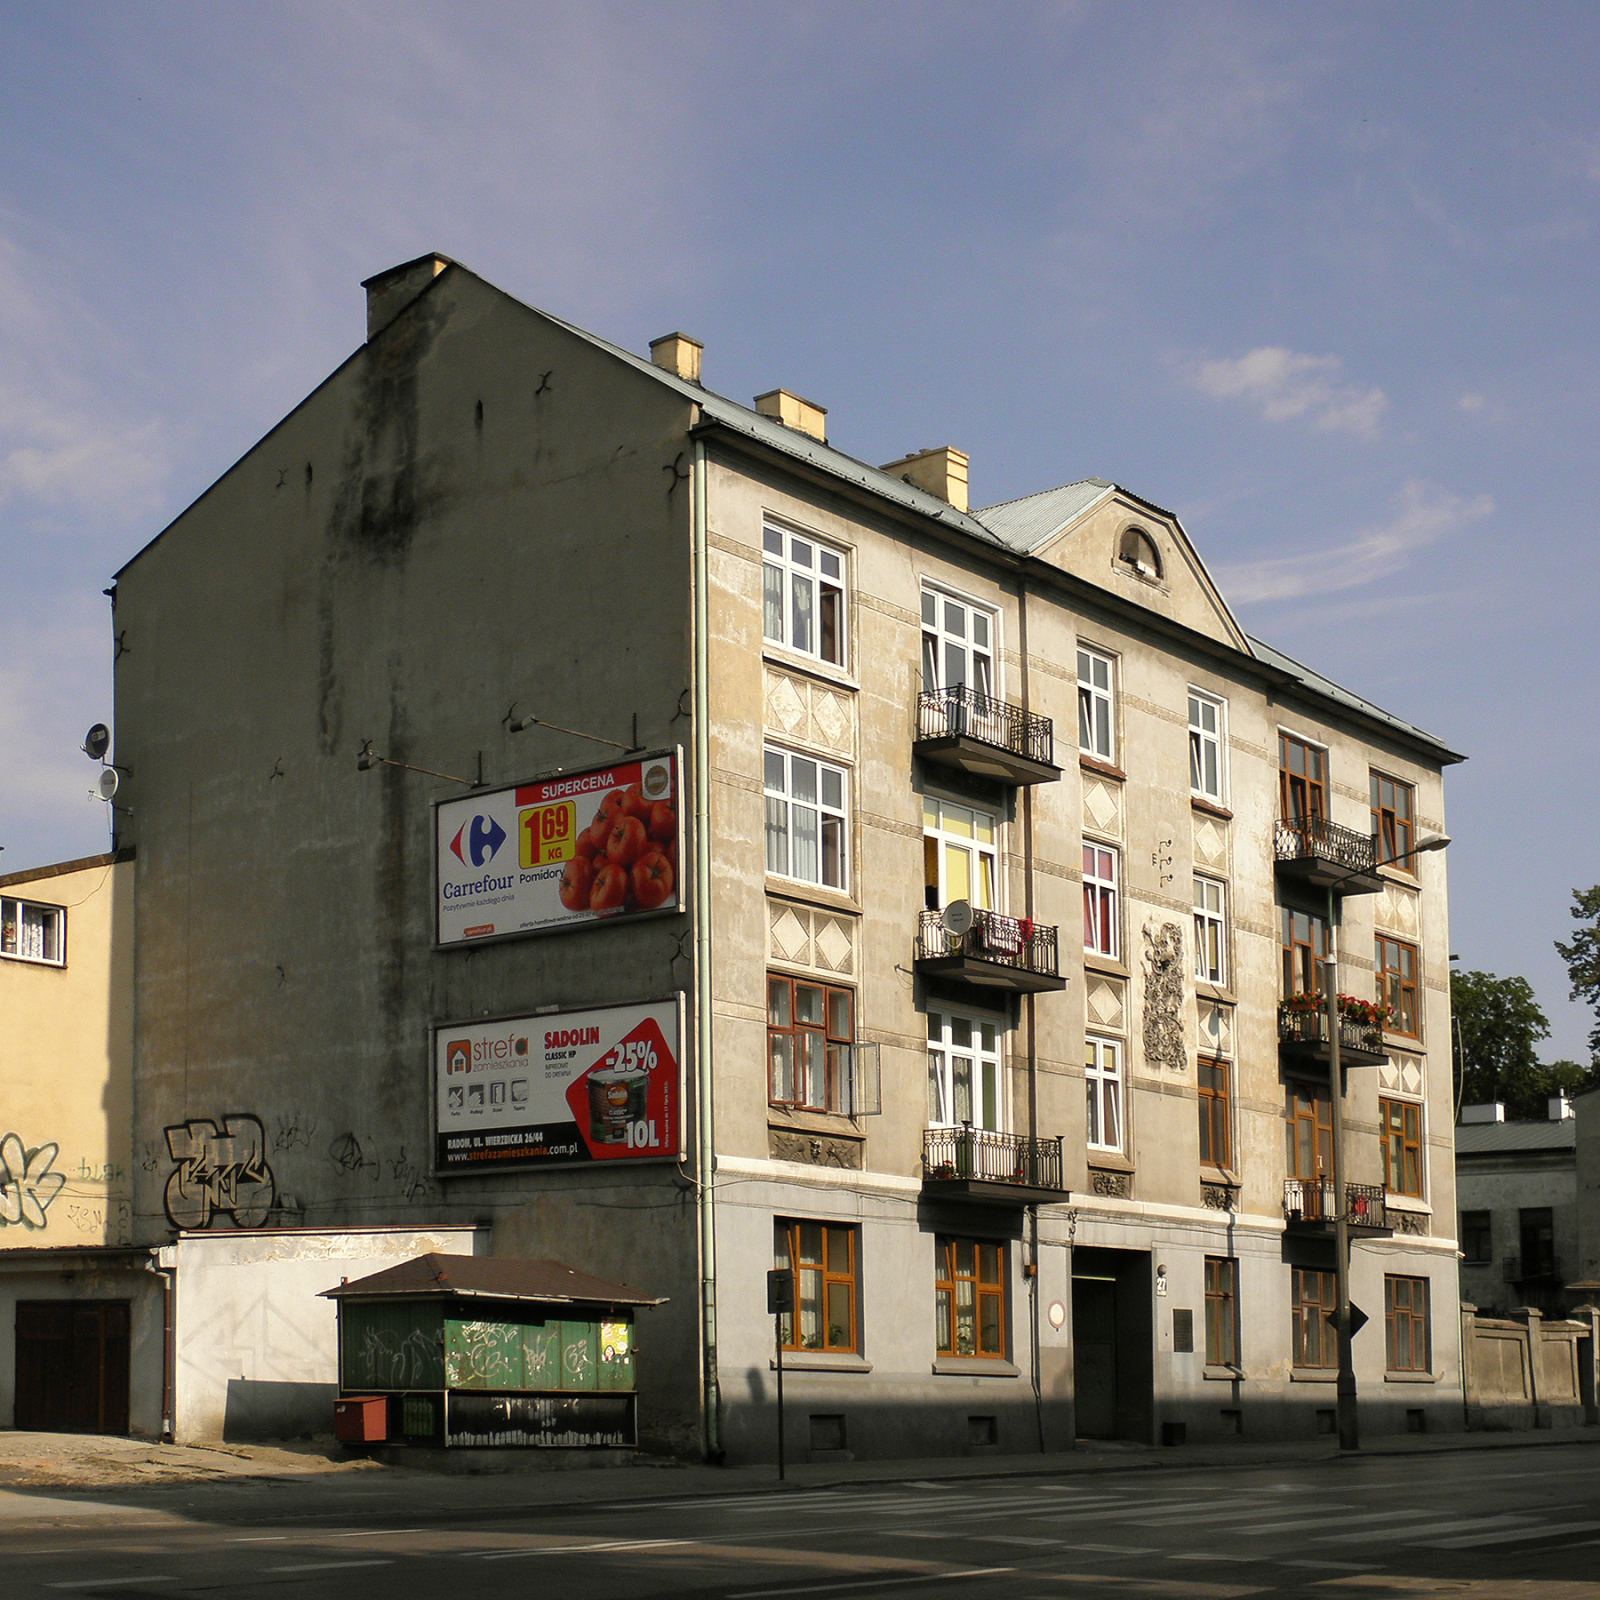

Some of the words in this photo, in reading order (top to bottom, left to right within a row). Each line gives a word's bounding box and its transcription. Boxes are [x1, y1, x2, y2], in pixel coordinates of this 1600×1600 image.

[541, 772, 615, 799] SUPERCENA
[547, 846, 563, 861] KG
[443, 873, 515, 900] Carrefour
[519, 868, 565, 884] Pomidory
[473, 1033, 529, 1061] strefa
[544, 1026, 600, 1050] SADOLIN
[473, 1058, 529, 1073] zamieszkania
[545, 1051, 567, 1061] CLASSIC
[605, 1040, 658, 1073] -25%
[447, 1138, 473, 1150] RADOM,
[485, 1133, 524, 1147] WIERZBICKA
[627, 1119, 660, 1149] 10L
[447, 1142, 578, 1163] www.strefazamieszkania.com.pl
[1156, 1278, 1167, 1291] 27
